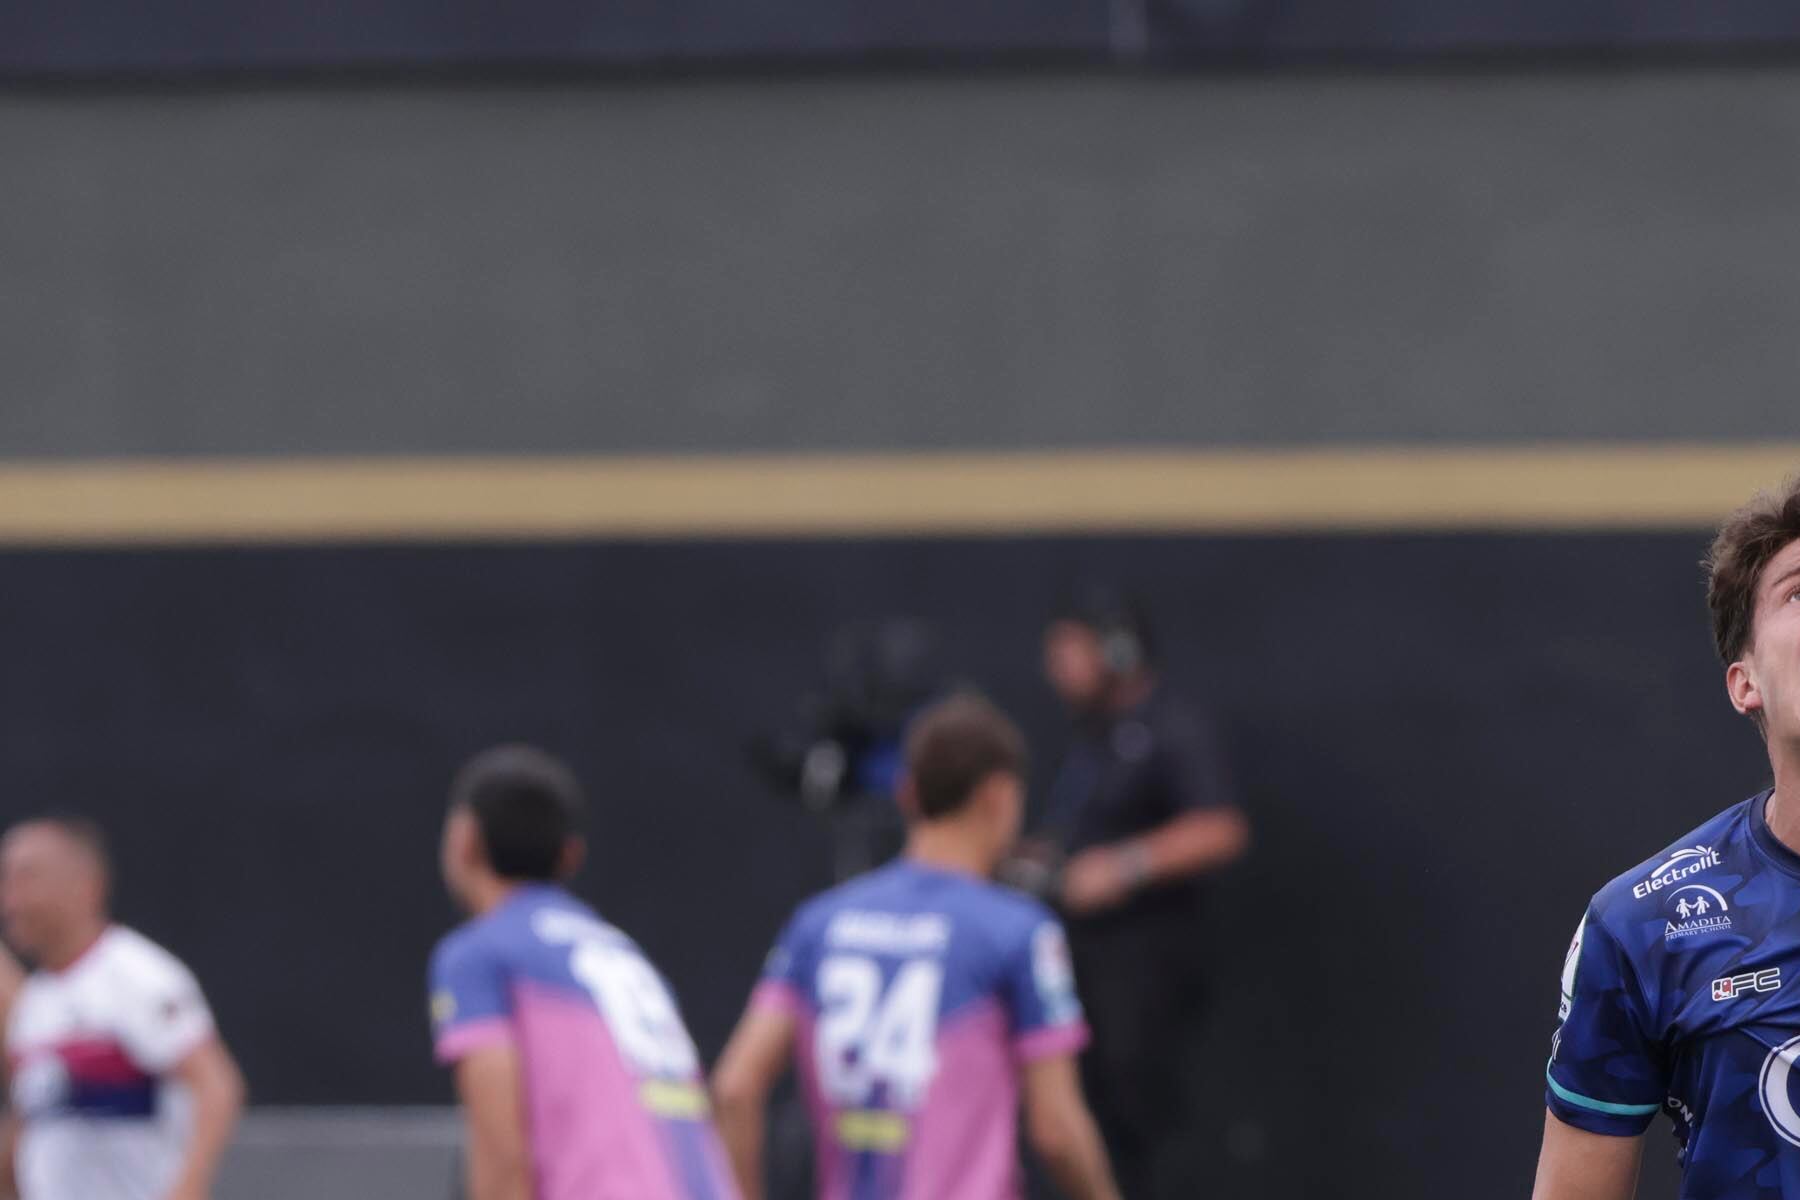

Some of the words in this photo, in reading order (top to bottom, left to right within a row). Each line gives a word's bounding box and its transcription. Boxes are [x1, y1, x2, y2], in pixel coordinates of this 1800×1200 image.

[1633, 850, 1721, 899] Electrolit
[1664, 915, 1732, 934] AMADITA
[1665, 929, 1698, 942] PRIMARY
[1700, 923, 1731, 935] SCHOOL
